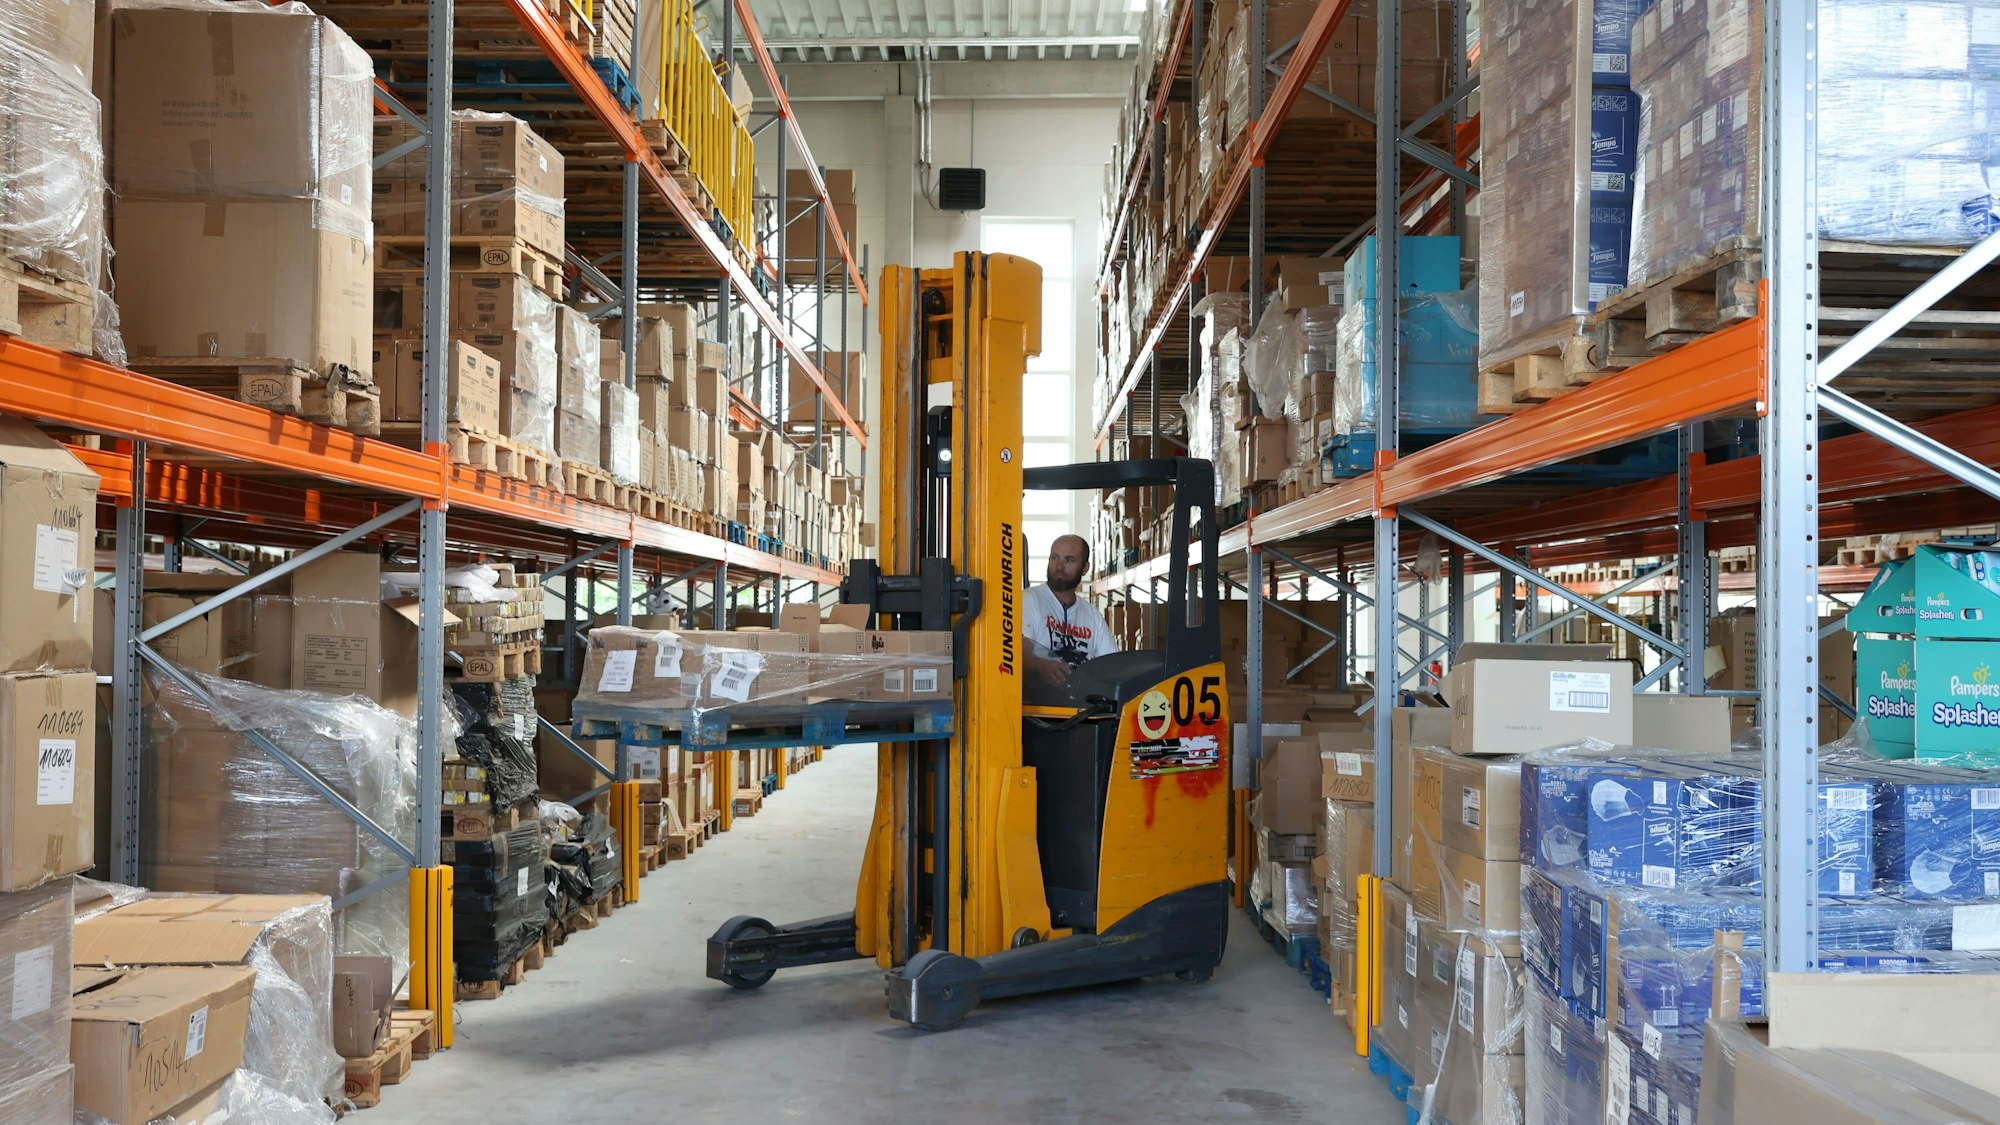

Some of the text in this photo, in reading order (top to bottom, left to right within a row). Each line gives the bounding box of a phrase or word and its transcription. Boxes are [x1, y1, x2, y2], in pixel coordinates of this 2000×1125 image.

[1595, 21, 1620, 33] Tempo
[1592, 137, 1617, 150] Tempo
[487, 253, 505, 262] EPAL
[1591, 249, 1616, 262] Tempo
[250, 383, 278, 397] EPAL
[51, 505, 82, 531] 110664
[999, 522, 1014, 676] JUNGHEINRICH
[1927, 596, 1950, 607] Pampers
[1919, 608, 1955, 622] Splashers
[470, 662, 489, 672] EPAL
[1881, 670, 1916, 692] Pampers
[1950, 675, 2000, 699] Pampers
[1173, 676, 1221, 726] 05
[38, 710, 83, 735] 110664
[40, 748, 72, 769] 110664
[1650, 823, 1672, 836] Tempo
[1832, 841, 1860, 854] Tempo
